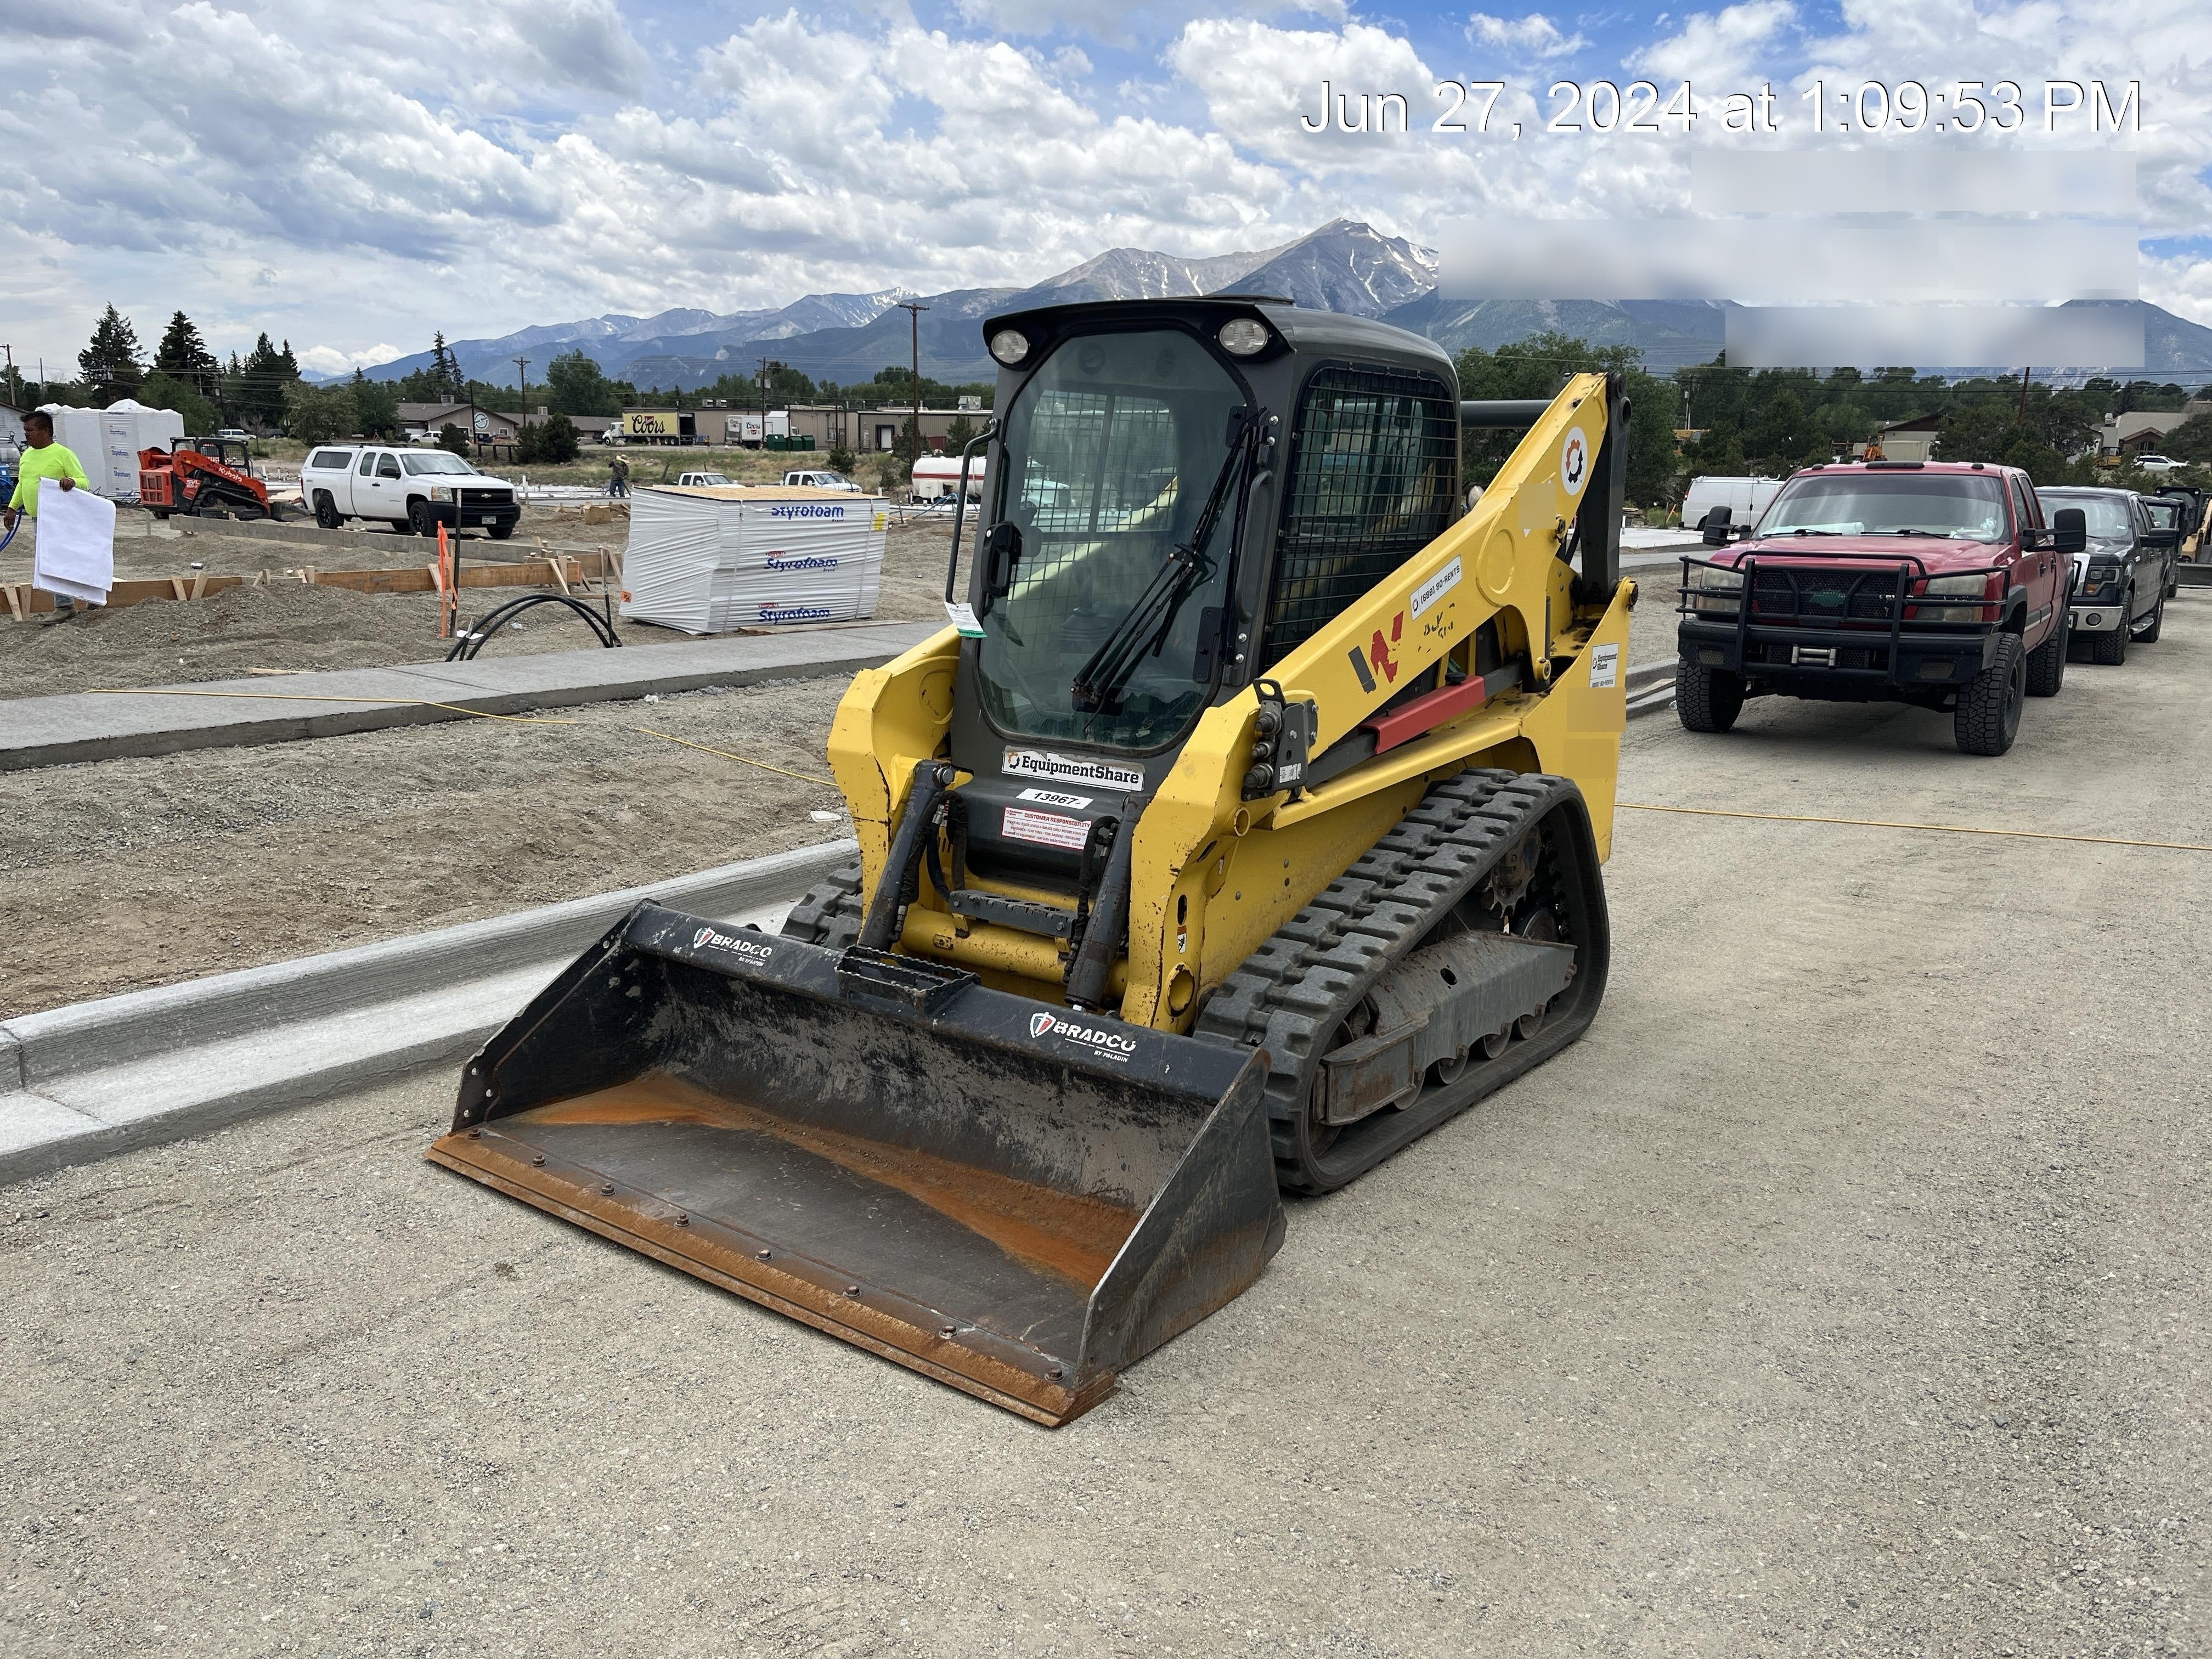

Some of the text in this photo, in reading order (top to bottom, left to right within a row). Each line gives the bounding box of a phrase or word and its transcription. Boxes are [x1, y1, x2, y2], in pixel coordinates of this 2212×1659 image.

[632, 414, 665, 433] Coors
[219, 466, 242, 482] Kubota
[772, 505, 844, 520] Styrofoam
[764, 557, 838, 572] Styrofoam
[1436, 565, 1460, 591] 80-RENTS
[758, 607, 830, 624] Styrofoam
[1022, 755, 1139, 784] EquipmentShare
[1034, 791, 1079, 805] 13967
[1024, 812, 1090, 828] CUSTOMER RESPONSIBILITY
[710, 934, 772, 957] BRADCO
[1053, 1021, 1137, 1052] BRADCO
[1103, 1052, 1128, 1063] PALADIN
